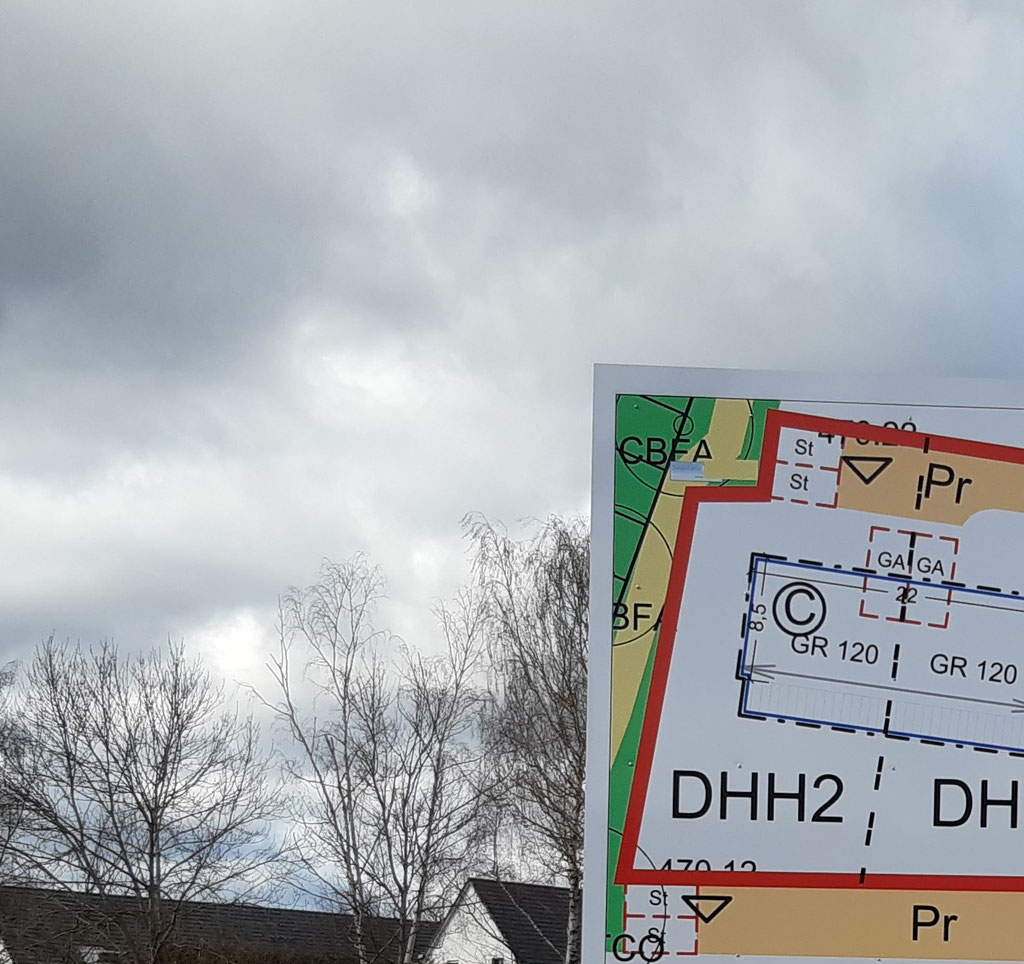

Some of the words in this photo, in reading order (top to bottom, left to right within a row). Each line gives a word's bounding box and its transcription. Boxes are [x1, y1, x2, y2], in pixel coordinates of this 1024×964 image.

[794, 438, 815, 458] St
[789, 473, 809, 492] St
[924, 462, 972, 504] Pr
[877, 551, 906, 571] GA
[917, 556, 945, 577] GA
[790, 634, 829, 658] GR
[838, 640, 879, 665] 120
[929, 653, 968, 679] GR
[976, 660, 1018, 685] 120
[671, 769, 845, 823] DHH2
[911, 904, 958, 941] Pr
